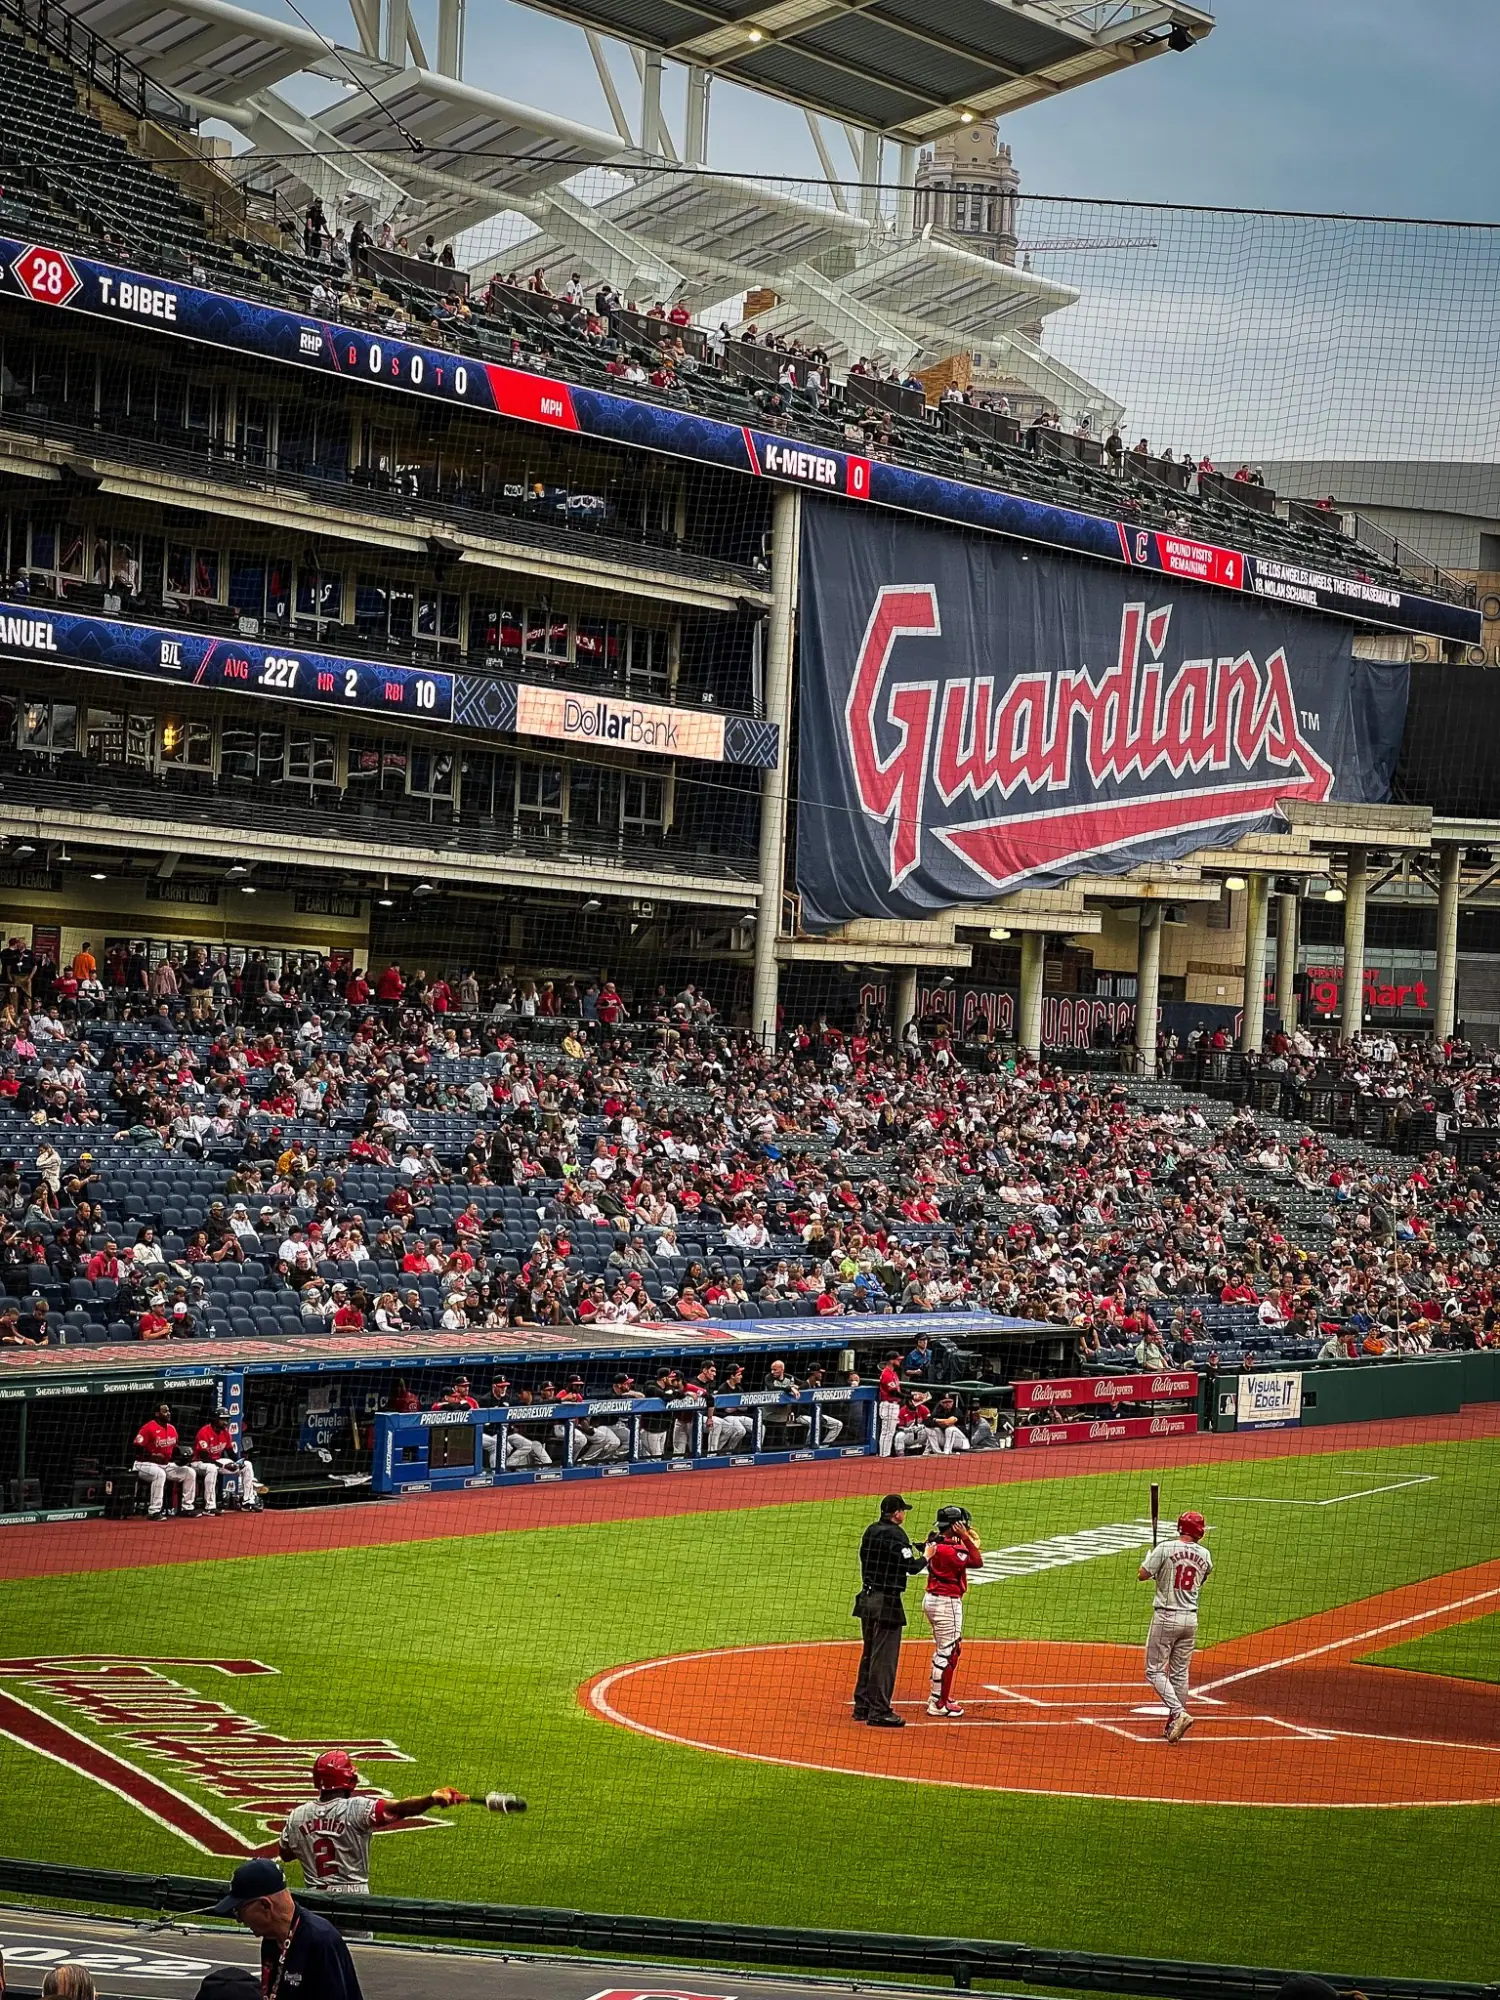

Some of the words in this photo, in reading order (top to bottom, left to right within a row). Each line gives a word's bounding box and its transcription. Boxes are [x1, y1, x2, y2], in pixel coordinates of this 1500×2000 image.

[32, 257, 62, 295] 28
[300, 332, 322, 351] RHP
[349, 346, 357, 364] B
[369, 344, 382, 373] 0
[391, 357, 399, 376] S
[411, 355, 424, 384] 0
[435, 367, 443, 386] T
[455, 366, 467, 394] 0
[540, 397, 563, 418] MPH
[765, 443, 837, 485] K-METER
[854, 465, 863, 490] 0
[1166, 540, 1191, 557] MOUND
[1191, 545, 1213, 562] VISITS
[1169, 556, 1207, 576] REMAINING
[1225, 559, 1234, 581] 4
[1255, 560, 1269, 575] THE
[1269, 562, 1281, 579] LOS
[1280, 566, 1309, 586] ANGELES
[1307, 572, 1333, 594] ANGELS,
[1333, 579, 1346, 594] THE
[1345, 582, 1362, 599] FIRST
[1264, 580, 1286, 597] NOLAN
[161, 643, 181, 665] B/L
[224, 658, 249, 680] AVG
[258, 656, 299, 688] .227
[317, 672, 334, 692] HR
[344, 668, 358, 698] 2
[385, 682, 403, 702] RBI
[416, 679, 436, 709] 10
[845, 583, 1300, 892] Guardians
[1300, 710, 1320, 731] TM
[20, 870, 52, 889] LEMON
[159, 882, 188, 902] LARRY
[189, 886, 211, 903] DOBY
[306, 898, 330, 914] EARLY
[812, 1389, 853, 1401] PROGRESSIVE
[1031, 1384, 1055, 1404] Bally
[1054, 1389, 1072, 1399] SPORTS
[1094, 1380, 1118, 1400] Bally
[1116, 1385, 1134, 1396] SPORTS
[1151, 1376, 1175, 1396] Bally
[1173, 1381, 1190, 1391] SPORTS
[1247, 1377, 1282, 1393] VISUAL
[1282, 1380, 1294, 1405] IT
[588, 1400, 633, 1414] PROGRESSIVE
[740, 1394, 781, 1405] PROGRESSIVE
[1254, 1394, 1280, 1408] EDGE
[420, 1411, 471, 1426] PROGRESSIVE
[507, 1406, 554, 1420] PROGRESSIVE
[1029, 1427, 1051, 1445] Bally
[1089, 1422, 1111, 1440] Bally
[1110, 1426, 1126, 1436] SPORTS
[1150, 1418, 1171, 1435] Bally
[1174, 1564, 1197, 1591] 18
[312, 1836, 339, 1878] 2
